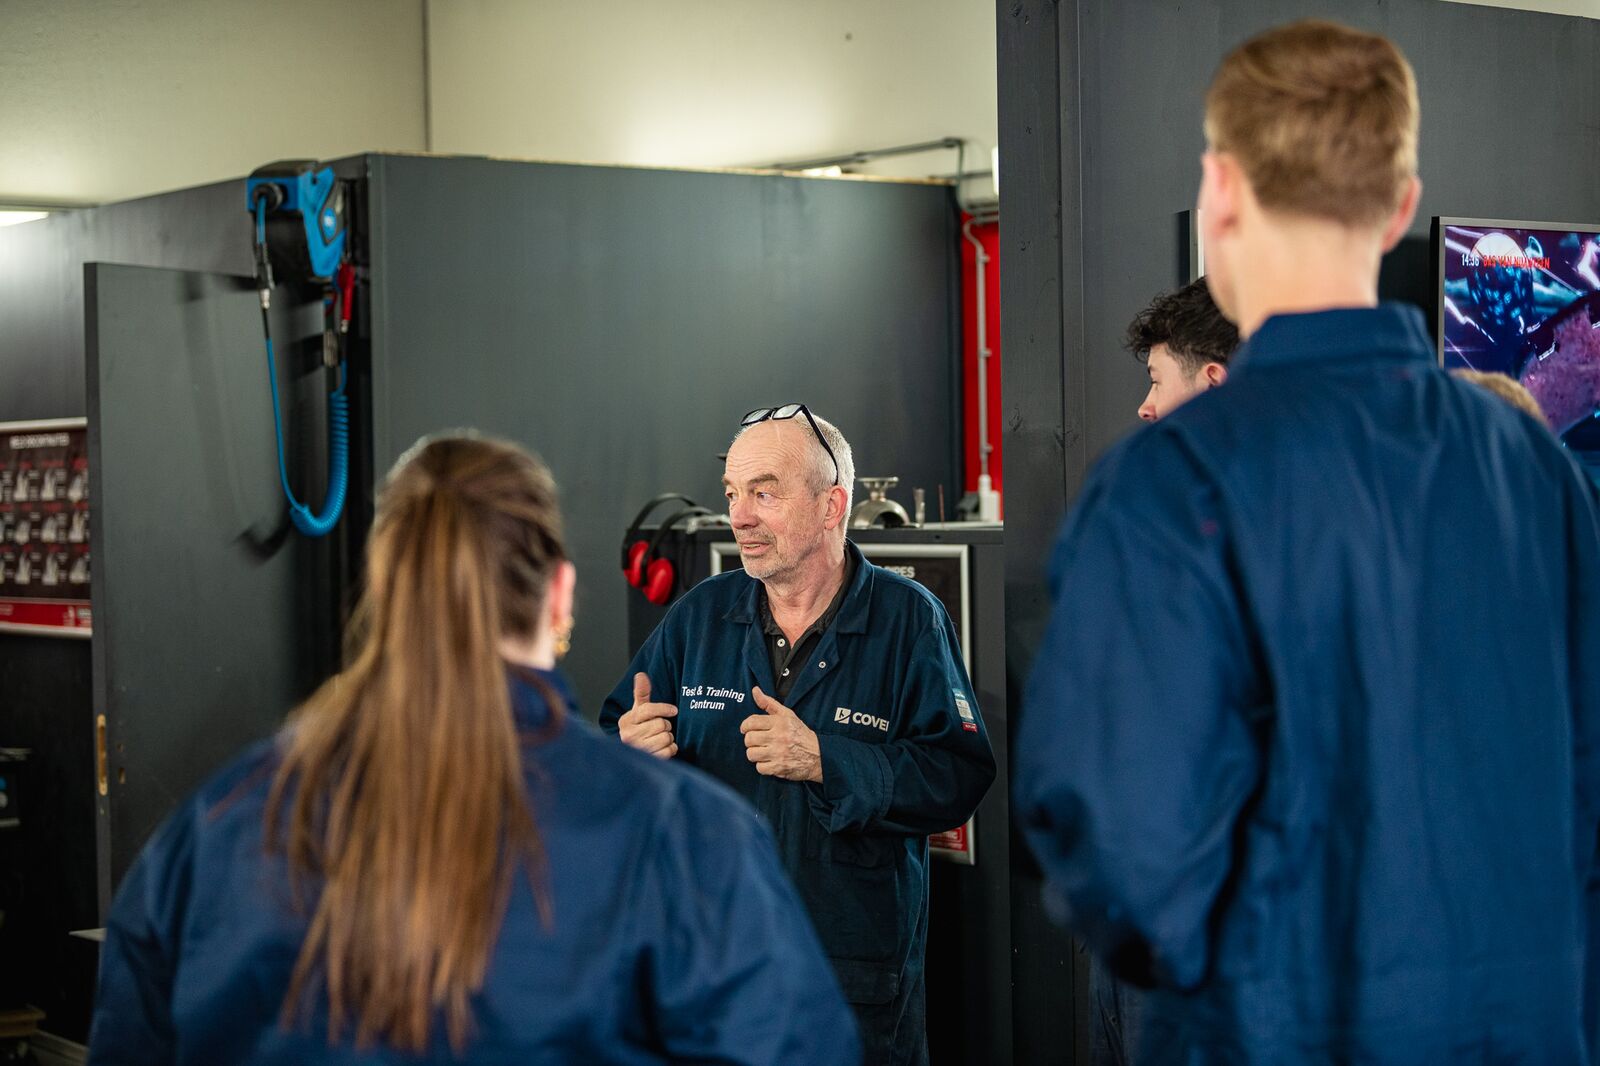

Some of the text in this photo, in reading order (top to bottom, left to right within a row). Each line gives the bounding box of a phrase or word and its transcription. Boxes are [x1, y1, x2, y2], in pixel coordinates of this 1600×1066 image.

[681, 685, 746, 703] Test & Training
[690, 698, 726, 710] Centrum
